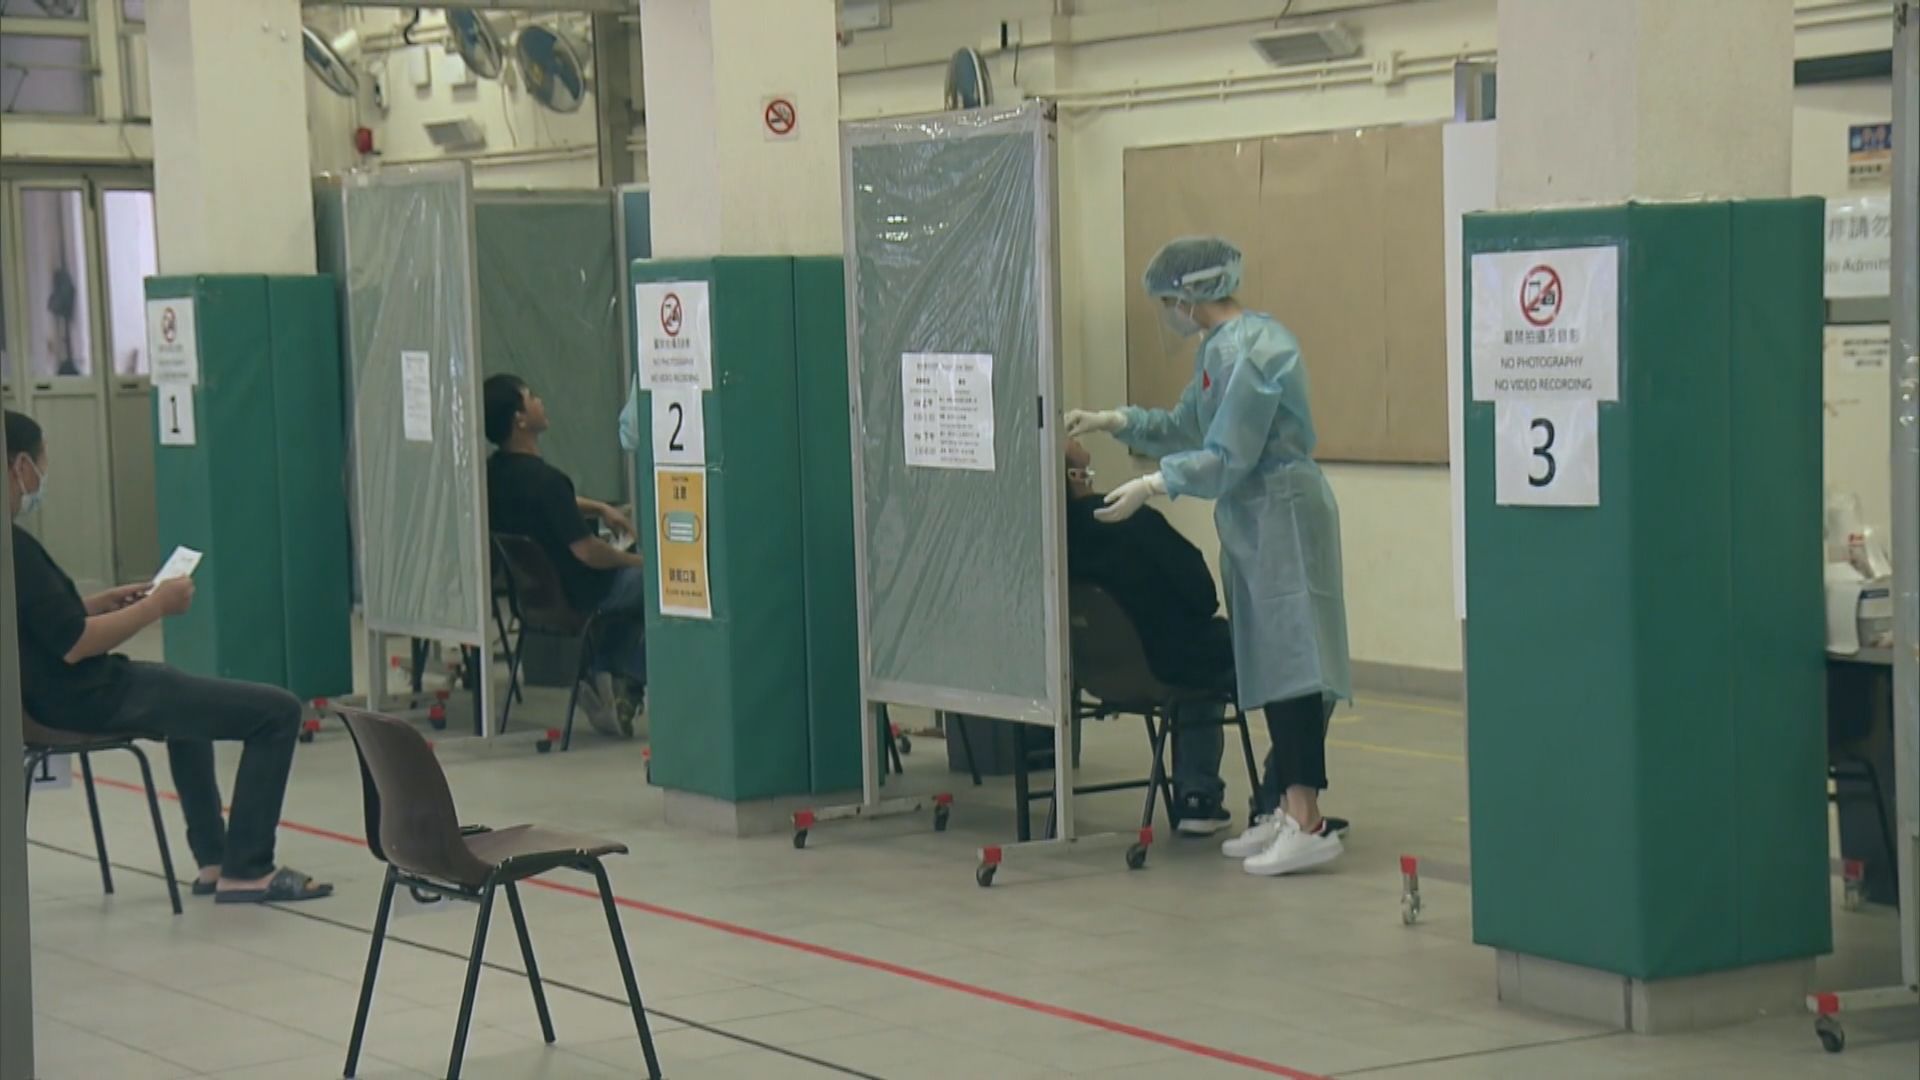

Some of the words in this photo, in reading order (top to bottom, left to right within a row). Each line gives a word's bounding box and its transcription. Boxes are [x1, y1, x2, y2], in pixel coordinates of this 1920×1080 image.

[1500, 357, 1515, 369] NO
[1516, 355, 1584, 368] PHOTOGRAPHY
[1494, 378, 1509, 391] NO
[1511, 378, 1537, 391] VIDEO
[1539, 377, 1592, 391] RECORDING
[170, 395, 180, 434] 1
[669, 402, 684, 451] 2
[1528, 418, 1556, 487] 3
